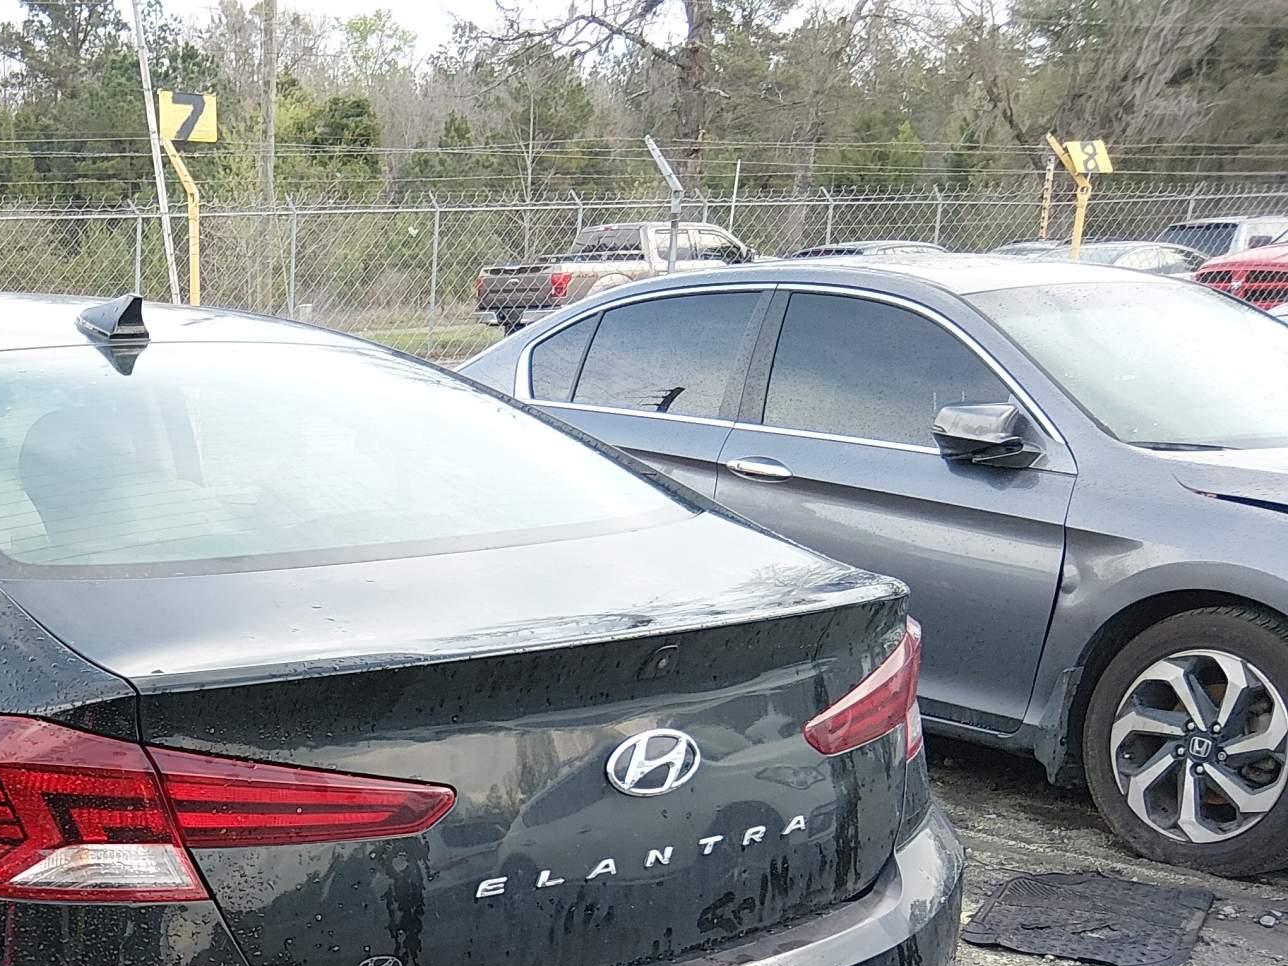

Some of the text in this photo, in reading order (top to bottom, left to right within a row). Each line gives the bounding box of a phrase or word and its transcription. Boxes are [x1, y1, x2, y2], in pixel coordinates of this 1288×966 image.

[171, 91, 206, 141] 7
[1079, 140, 1101, 172] 8
[474, 815, 808, 900] ELANTRA
